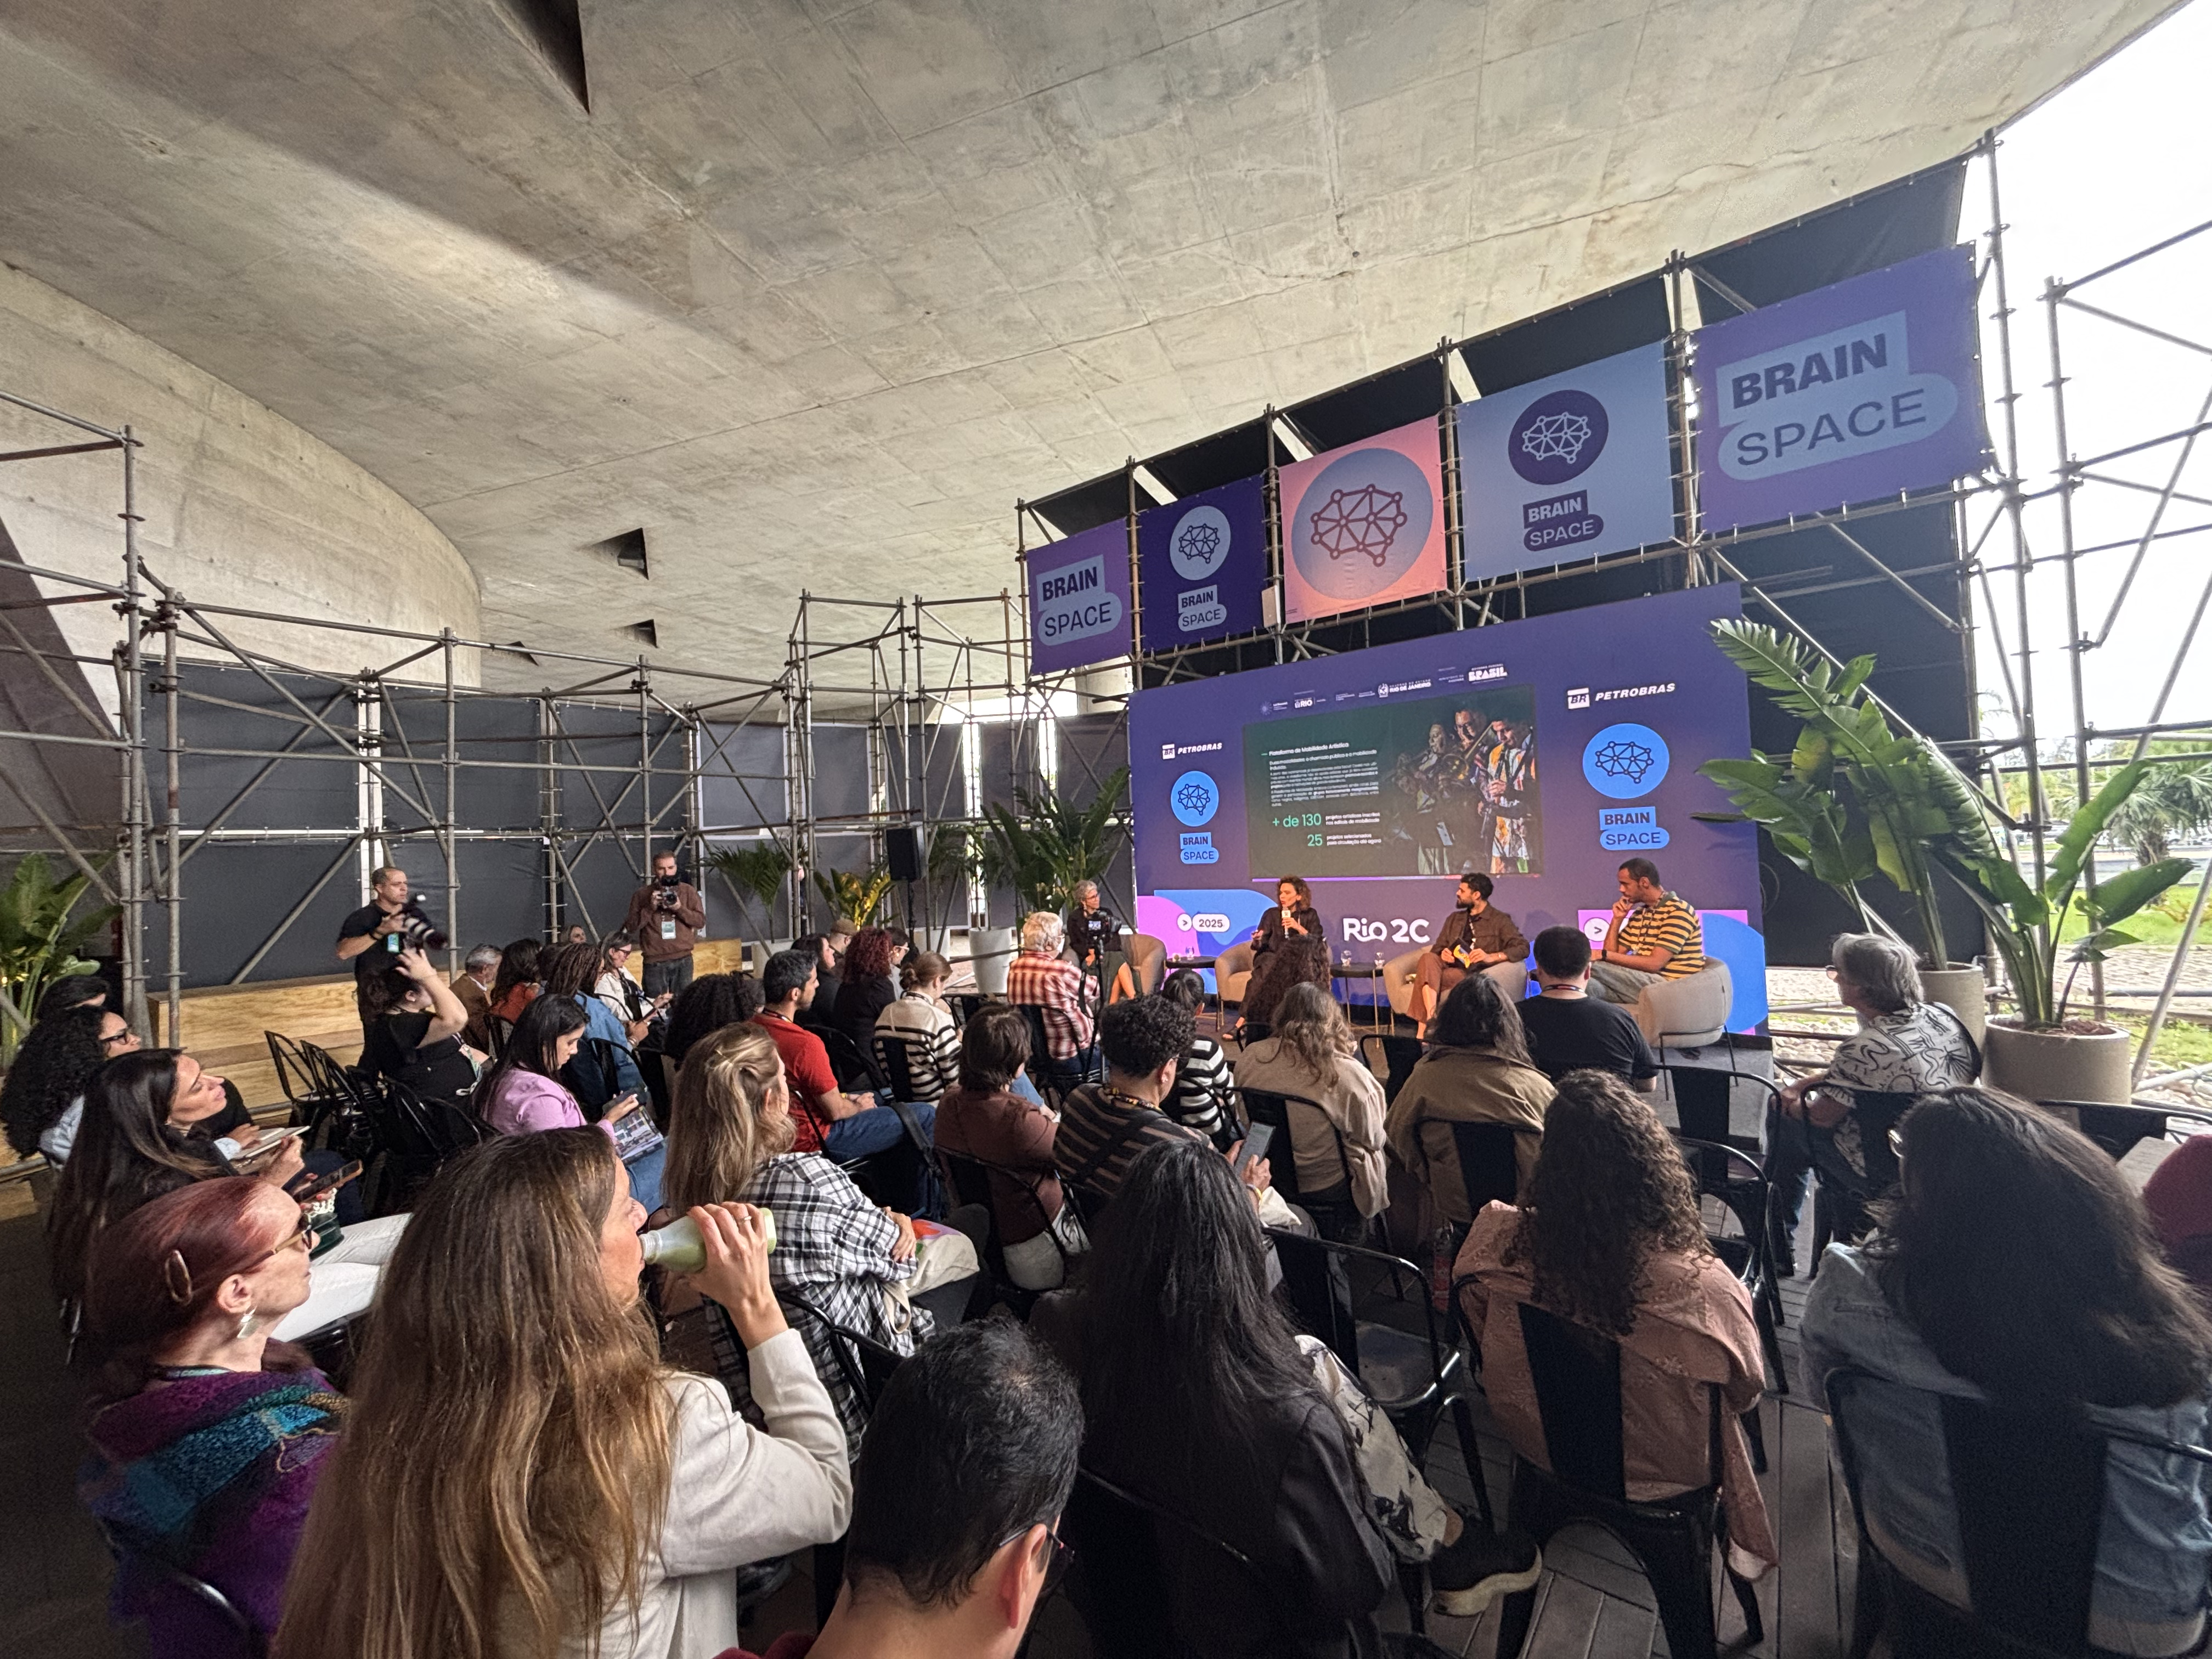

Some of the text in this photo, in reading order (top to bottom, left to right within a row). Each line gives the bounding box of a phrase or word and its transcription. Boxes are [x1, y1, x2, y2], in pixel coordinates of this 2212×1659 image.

[1732, 334, 1887, 409] BRAIN
[1737, 388, 1926, 465] SPACE
[1528, 497, 1581, 522] BRAIN
[1530, 520, 1594, 546] SPACE
[1042, 567, 1098, 601] BRAIN
[1181, 591, 1214, 608] BRAIN
[1045, 602, 1111, 637] SPACE
[1182, 608, 1221, 627] SPACE
[1468, 667, 1508, 682] BRASIL
[1408, 682, 1431, 690] JANEIRO
[1571, 683, 1675, 704] BR PETROBRAS
[1177, 742, 1222, 754] PETROBRAS
[1283, 815, 1299, 827] de
[1301, 813, 1322, 826] 130
[1604, 812, 1650, 826] BRAIN
[1183, 836, 1208, 845] BRAIN
[1307, 834, 1323, 847] 25
[1605, 832, 1661, 845] SPACE
[1183, 851, 1215, 860] SPACE
[1198, 919, 1223, 928] 2025
[1343, 918, 1430, 944] Rio 2C
